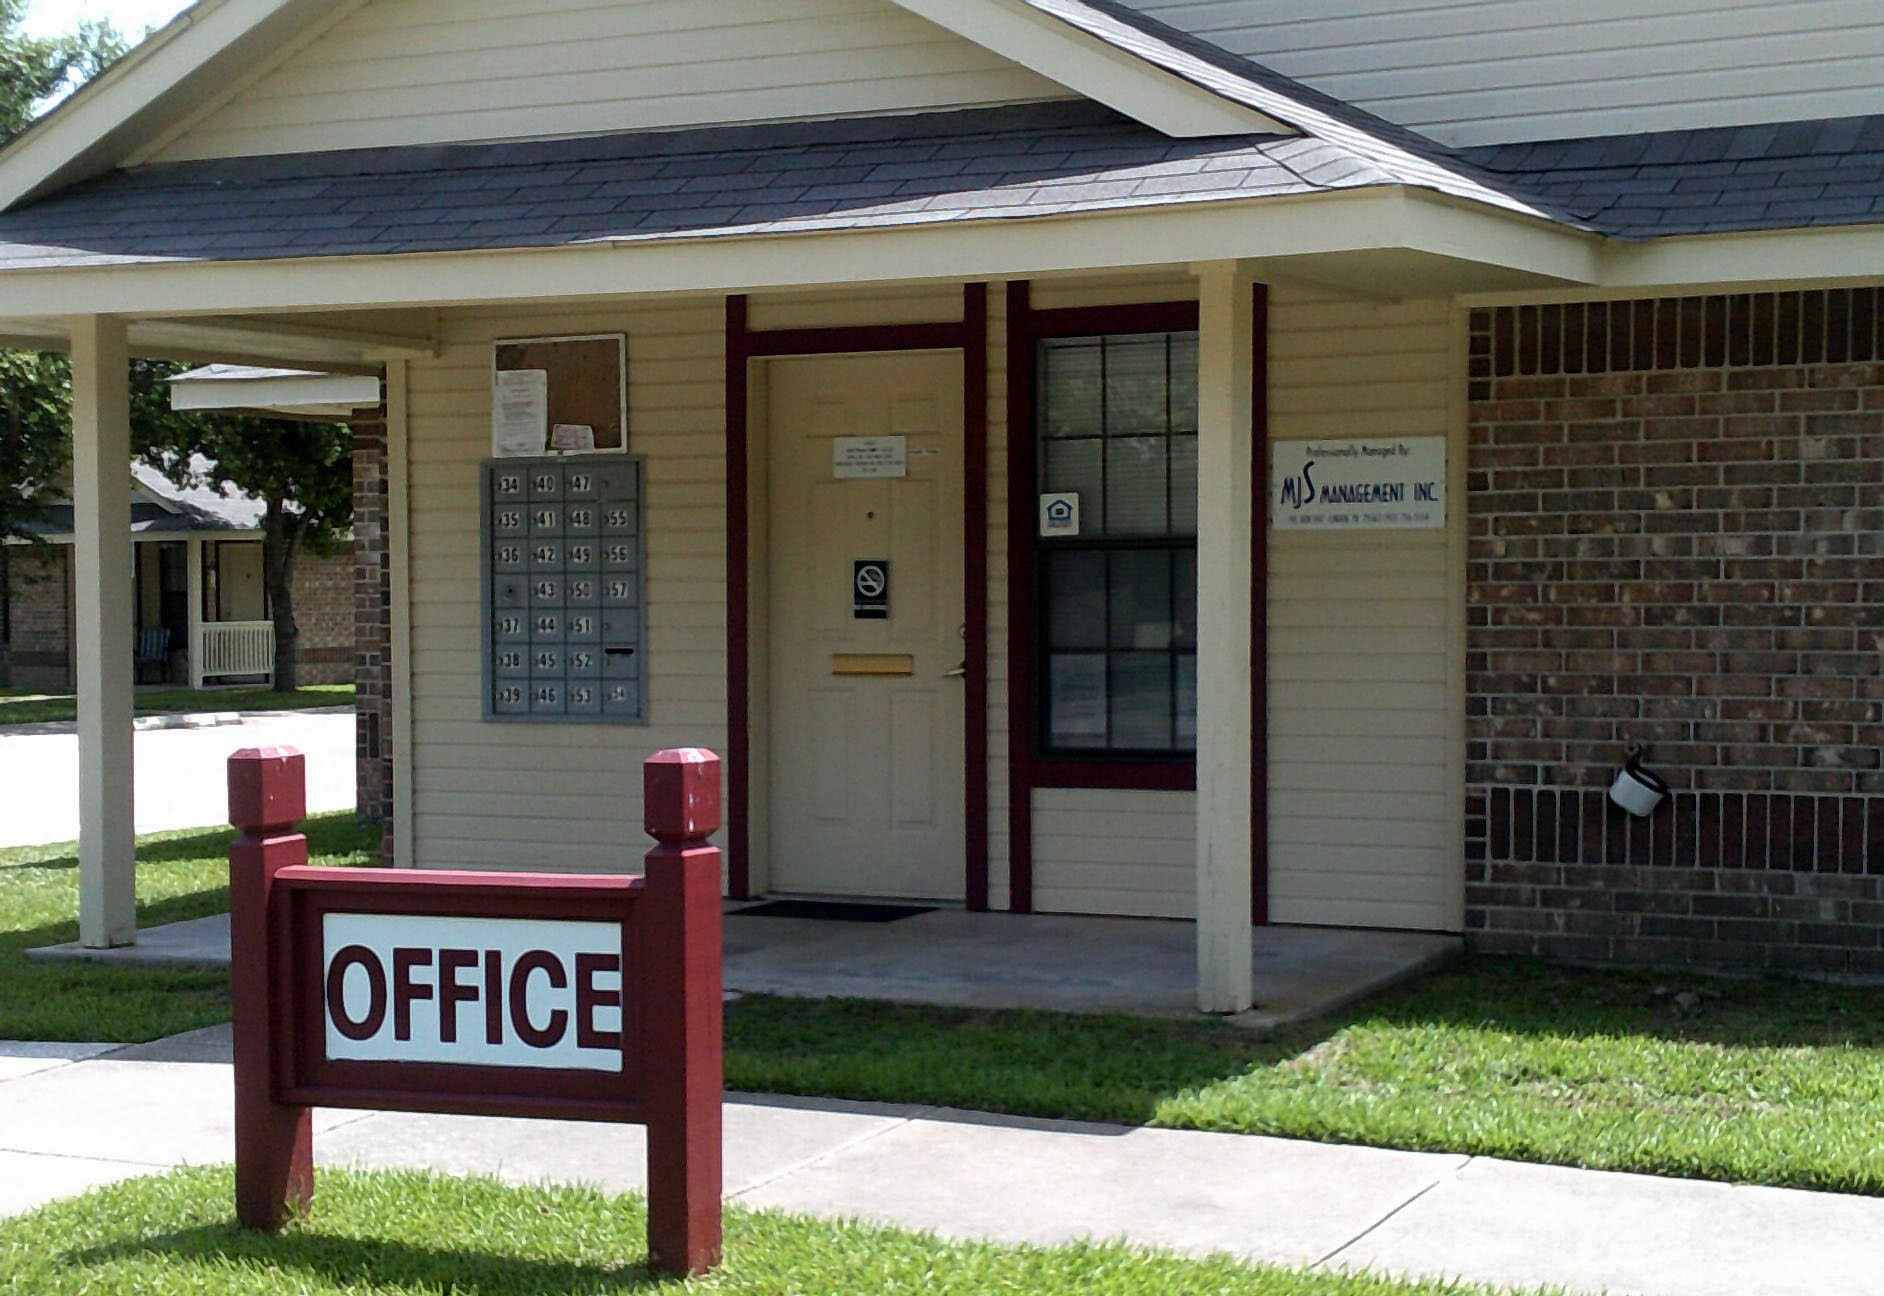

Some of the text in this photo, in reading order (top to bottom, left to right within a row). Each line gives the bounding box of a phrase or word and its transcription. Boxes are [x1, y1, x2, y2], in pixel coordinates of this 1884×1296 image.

[504, 478, 518, 491] 34
[538, 476, 553, 491] 40
[573, 475, 590, 491] 47
[1281, 460, 1315, 509] MJS
[1320, 482, 1404, 503] MANAGEMENT
[503, 512, 518, 527] 35
[538, 512, 553, 526] 41
[573, 511, 590, 526] 48
[503, 549, 518, 562] 36
[538, 548, 554, 561] 42
[539, 583, 554, 597] 43
[576, 583, 590, 597] 50
[612, 583, 627, 596] 57
[505, 618, 519, 632] 37
[540, 619, 555, 632] 44
[576, 618, 590, 632] 51
[504, 653, 520, 667] 38
[540, 653, 555, 667] 45
[575, 654, 591, 667] 52
[504, 688, 520, 702] 39
[540, 689, 555, 702] 46
[576, 689, 591, 702] 53
[327, 944, 622, 1049] OFFICE
